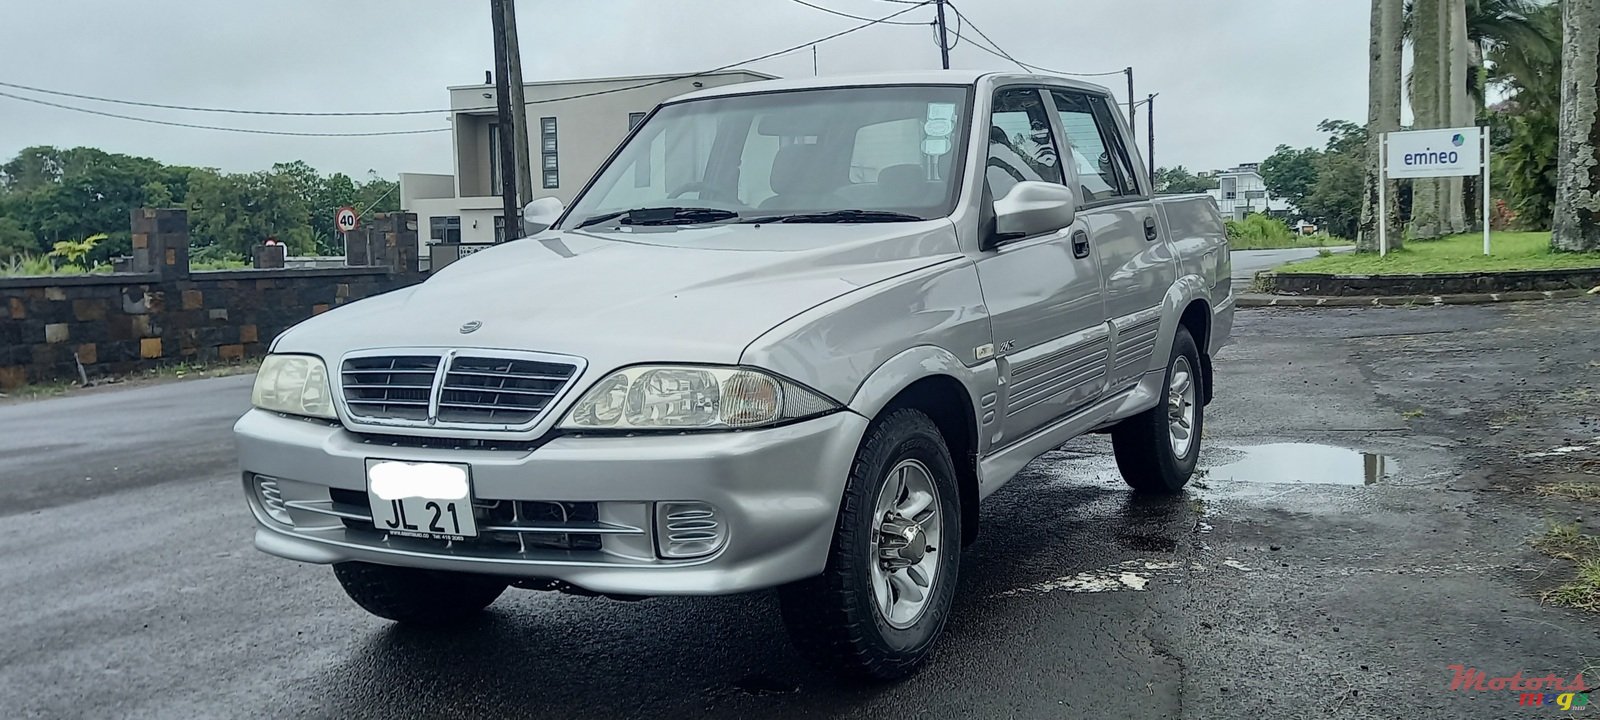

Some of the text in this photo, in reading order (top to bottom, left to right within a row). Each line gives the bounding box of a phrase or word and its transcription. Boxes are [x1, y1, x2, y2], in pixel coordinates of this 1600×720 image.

[1404, 147, 1458, 165] emineo
[340, 214, 354, 226] 40
[385, 499, 460, 534] JL 21
